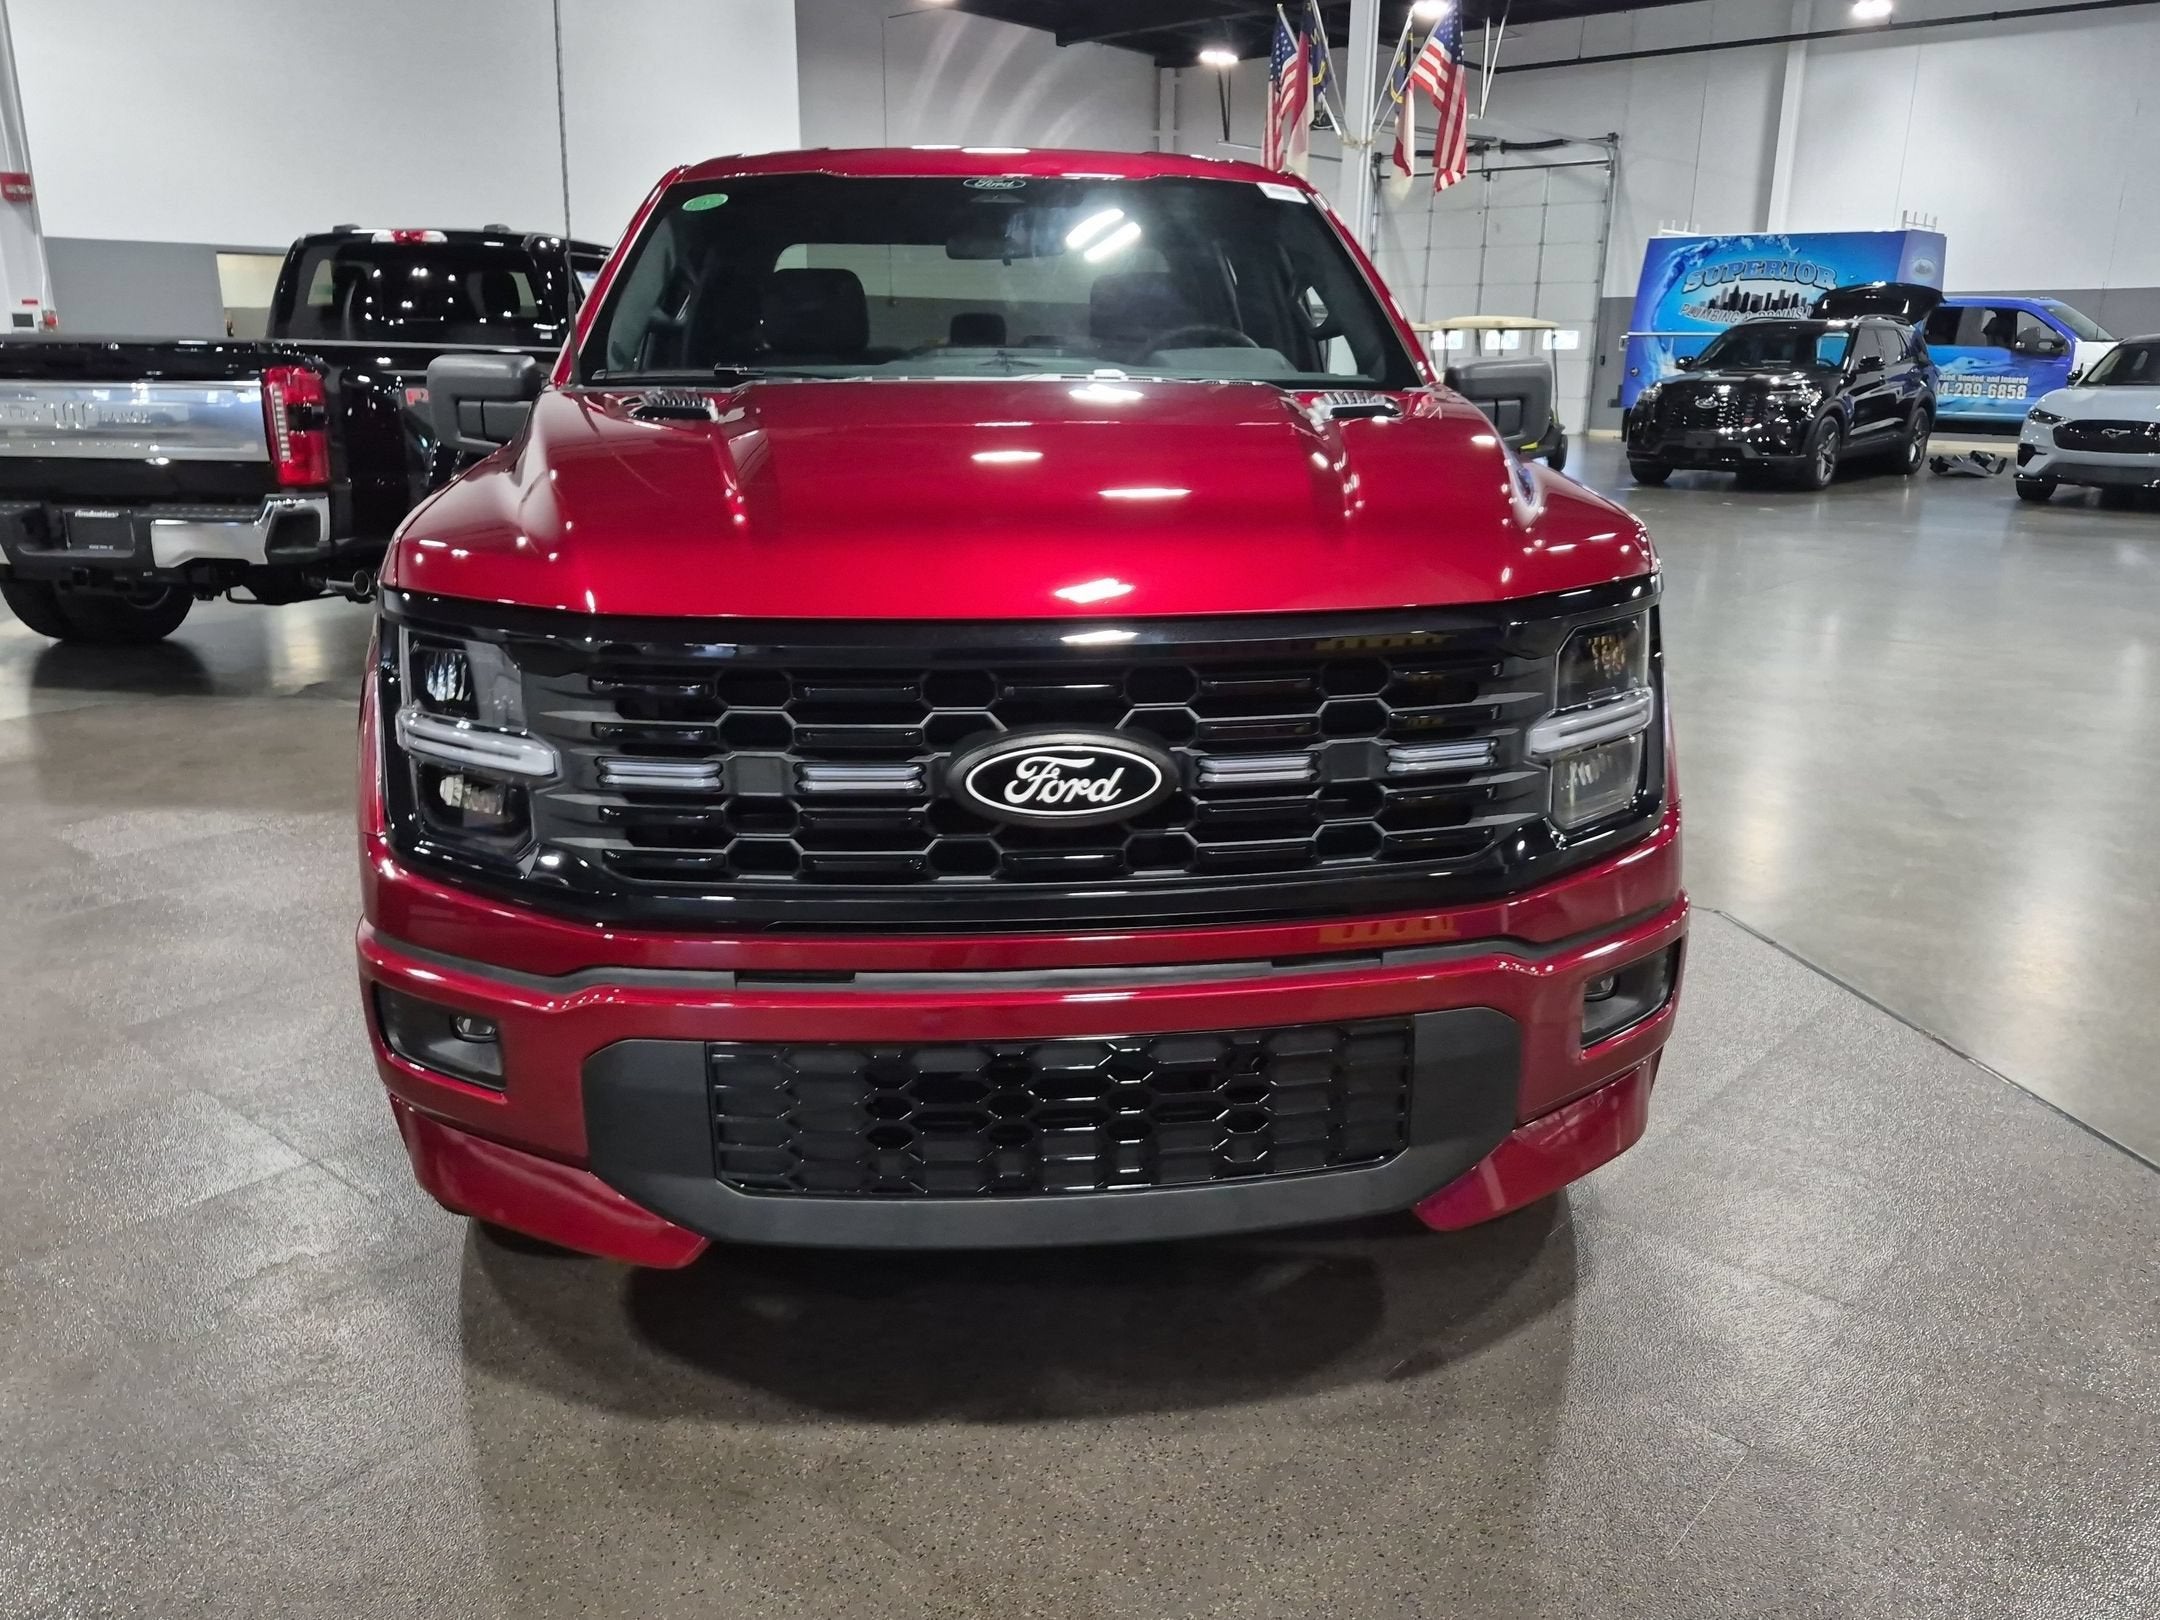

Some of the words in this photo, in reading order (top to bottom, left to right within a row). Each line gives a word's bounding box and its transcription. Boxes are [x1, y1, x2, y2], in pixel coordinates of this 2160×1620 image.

[1682, 259, 1837, 294] SUPERIOR
[1680, 303, 1740, 323] PLUMBING
[1004, 755, 1126, 804] Ford
